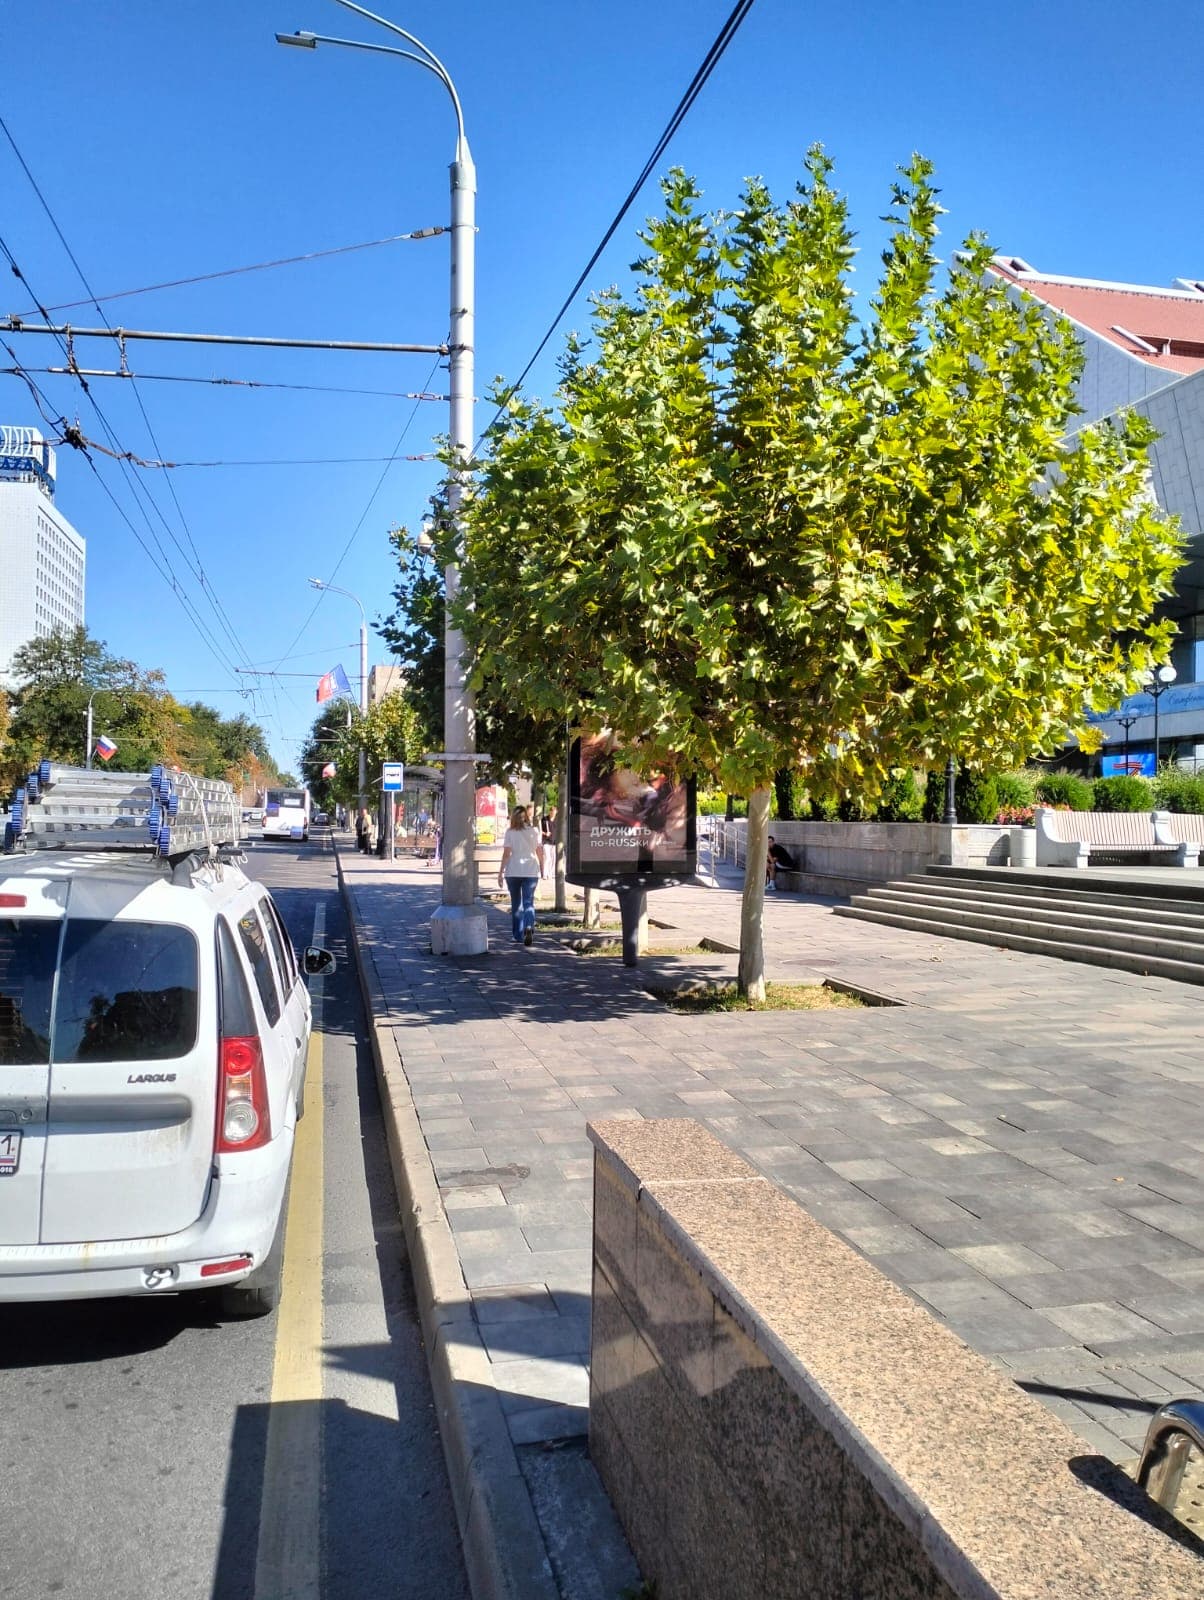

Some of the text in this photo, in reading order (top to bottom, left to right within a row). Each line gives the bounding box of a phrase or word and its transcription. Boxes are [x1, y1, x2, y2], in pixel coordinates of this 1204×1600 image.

[590, 826, 652, 838] ДРУЖИТЬ
[590, 838, 649, 848] по-RUSSки
[127, 1073, 177, 1084] LARGUS
